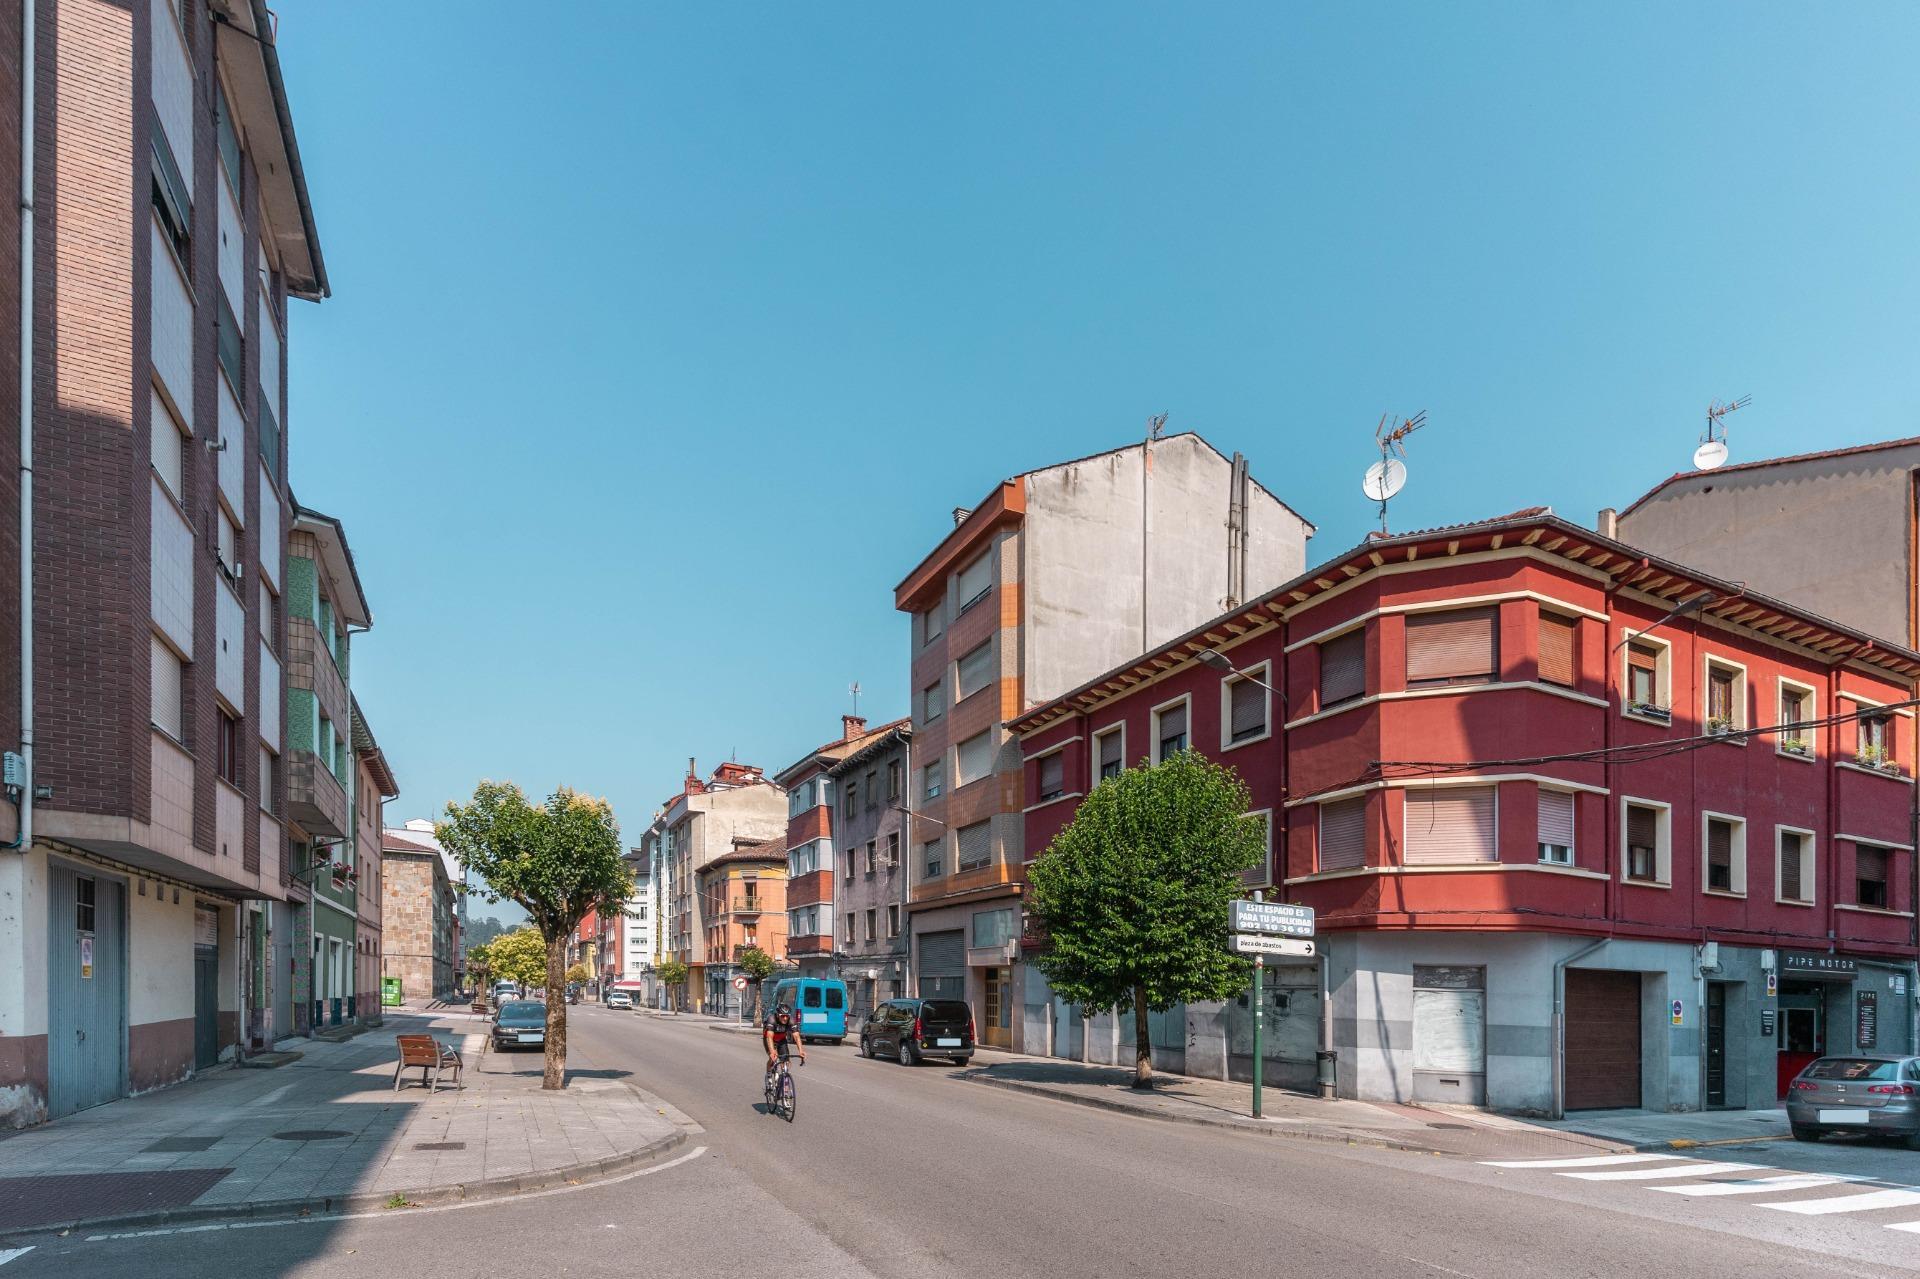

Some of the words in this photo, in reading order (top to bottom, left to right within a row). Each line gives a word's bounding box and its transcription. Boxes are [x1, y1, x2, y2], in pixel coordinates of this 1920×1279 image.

[1246, 904, 1263, 913] ESTE
[1264, 905, 1294, 916] ESPACIO
[1295, 908, 1304, 917] ES
[1239, 912, 1258, 922] PARA
[1259, 915, 1269, 923] TU
[1271, 916, 1312, 926] PUBLICIDAD
[1239, 921, 1261, 929] 902
[1264, 923, 1278, 931] 10
[1281, 925, 1295, 933] 36
[1788, 956, 1813, 966] PIPE
[1819, 959, 1854, 969] MOTOR
